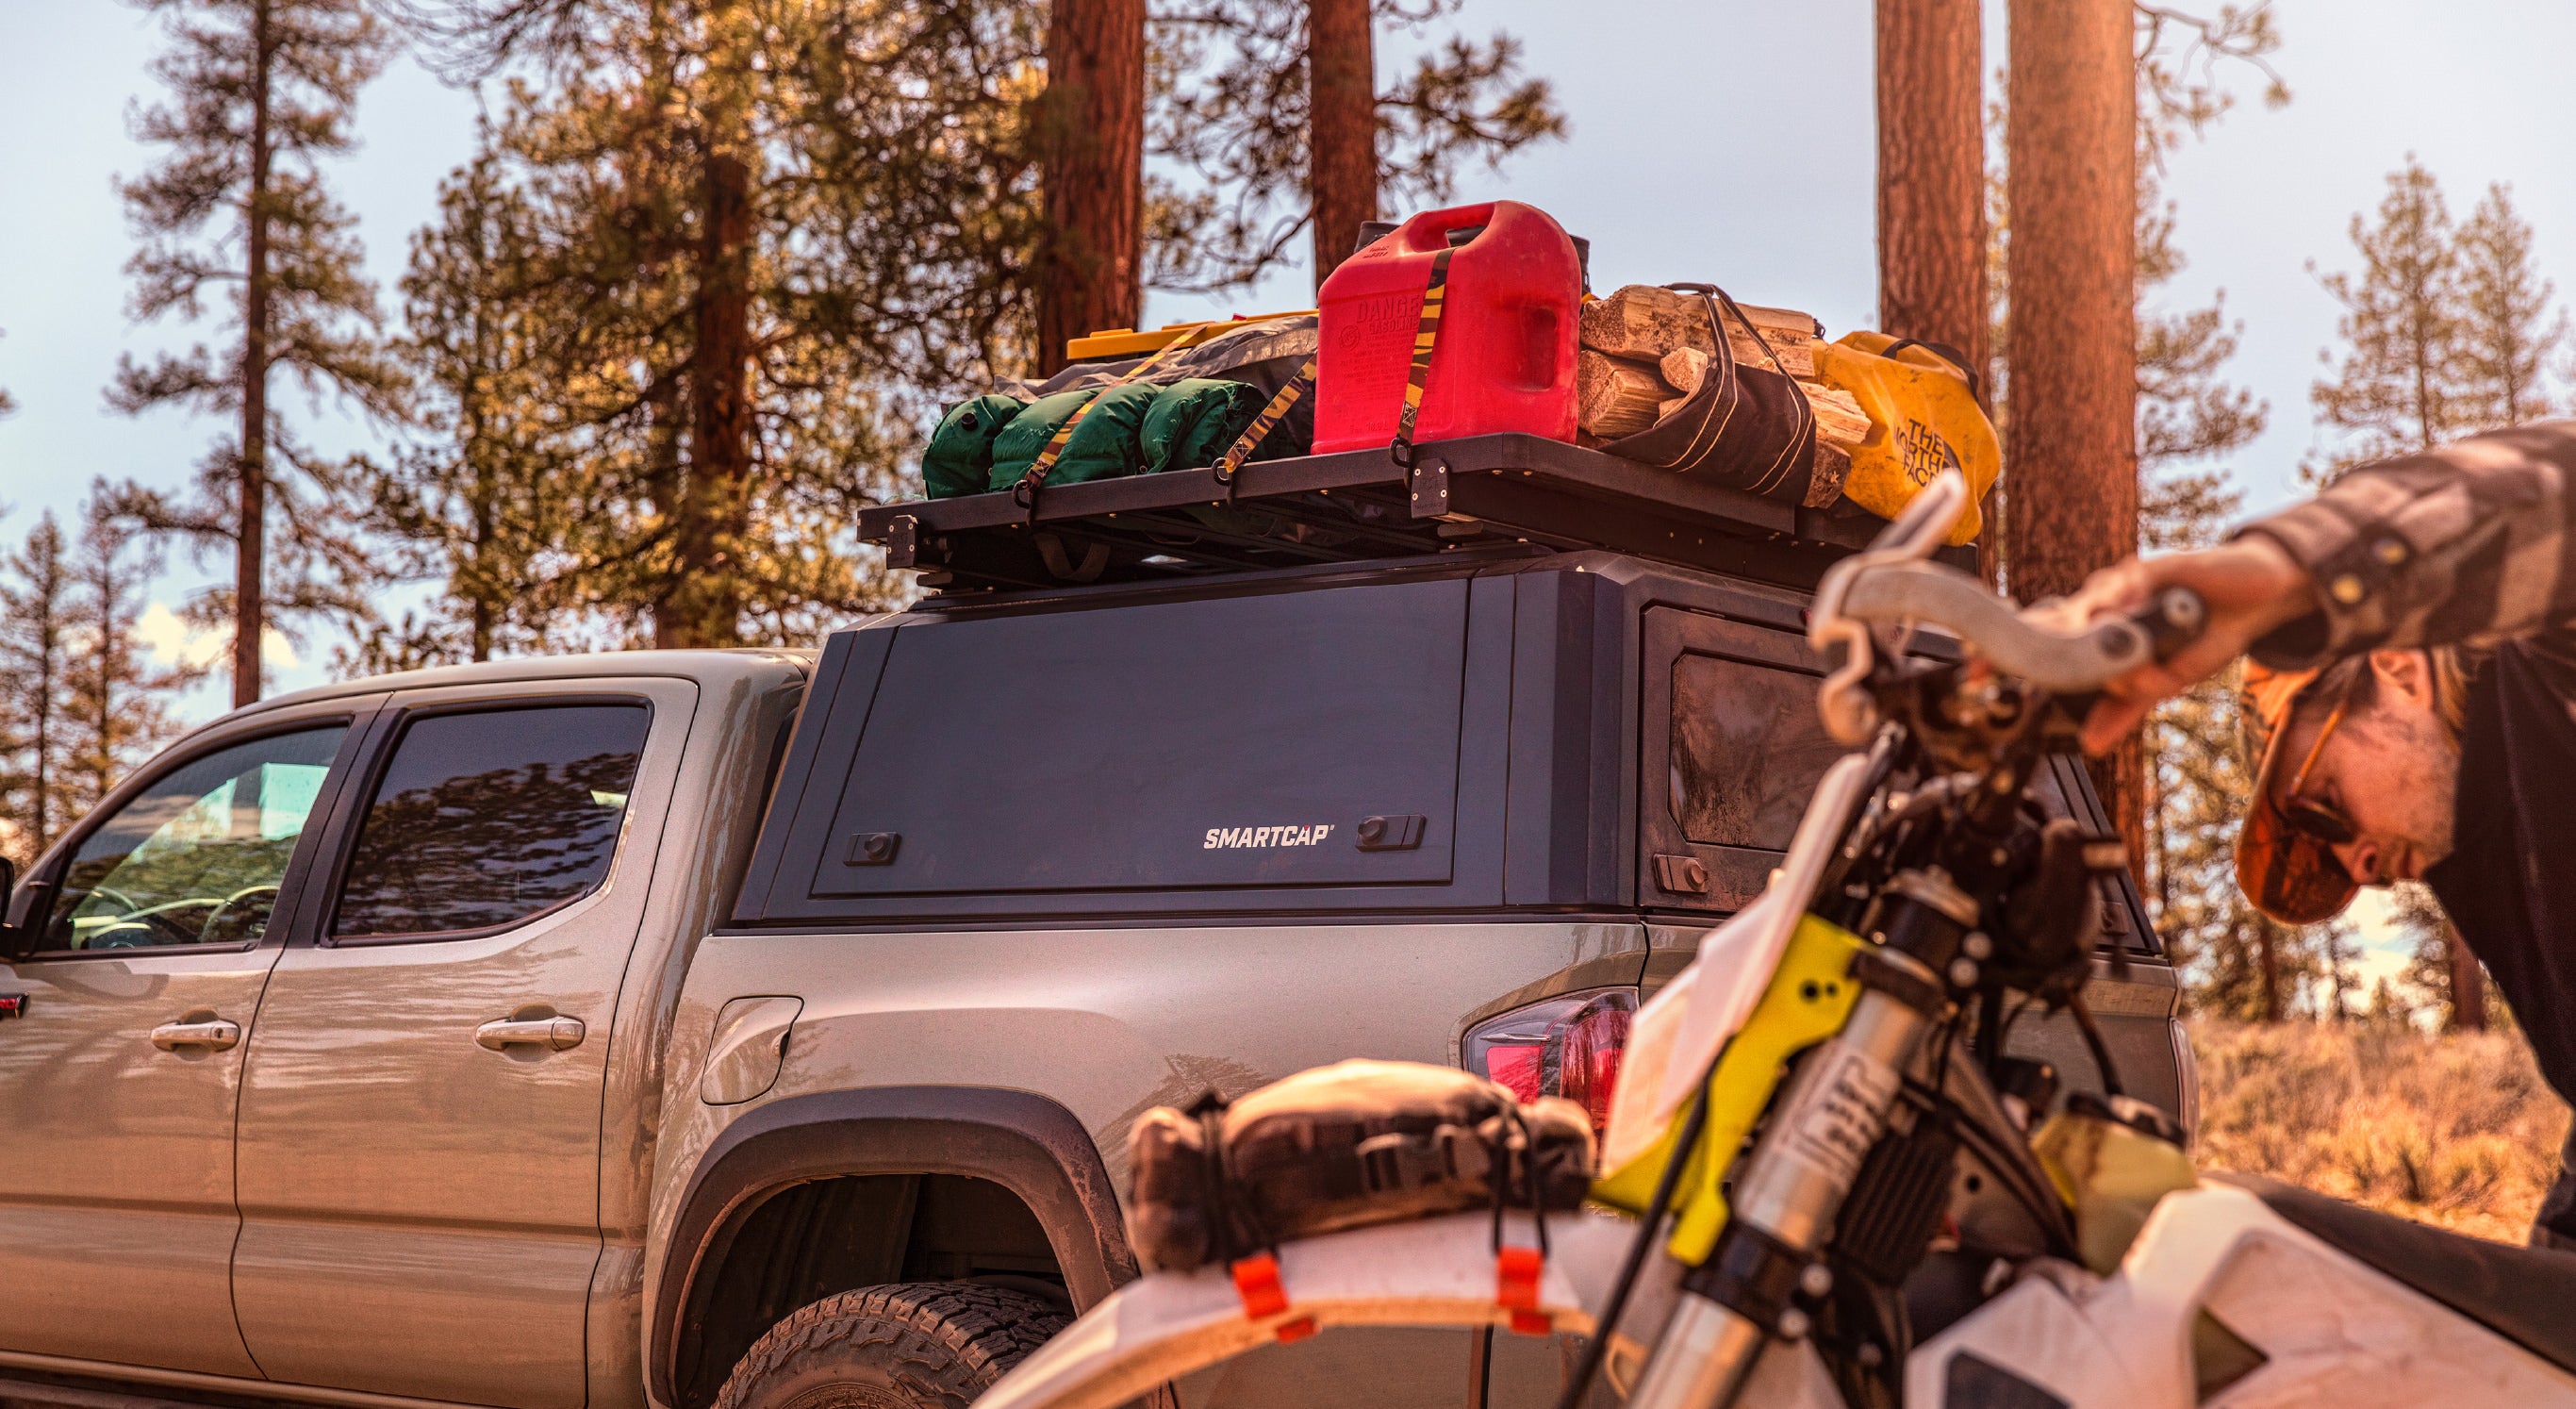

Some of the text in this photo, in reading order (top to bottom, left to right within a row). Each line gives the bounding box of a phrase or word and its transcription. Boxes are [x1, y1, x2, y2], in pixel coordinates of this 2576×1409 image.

[1357, 295, 1421, 323] DANGE
[1908, 418, 1943, 456] THE
[1203, 824, 1329, 849] SMARTCAP
